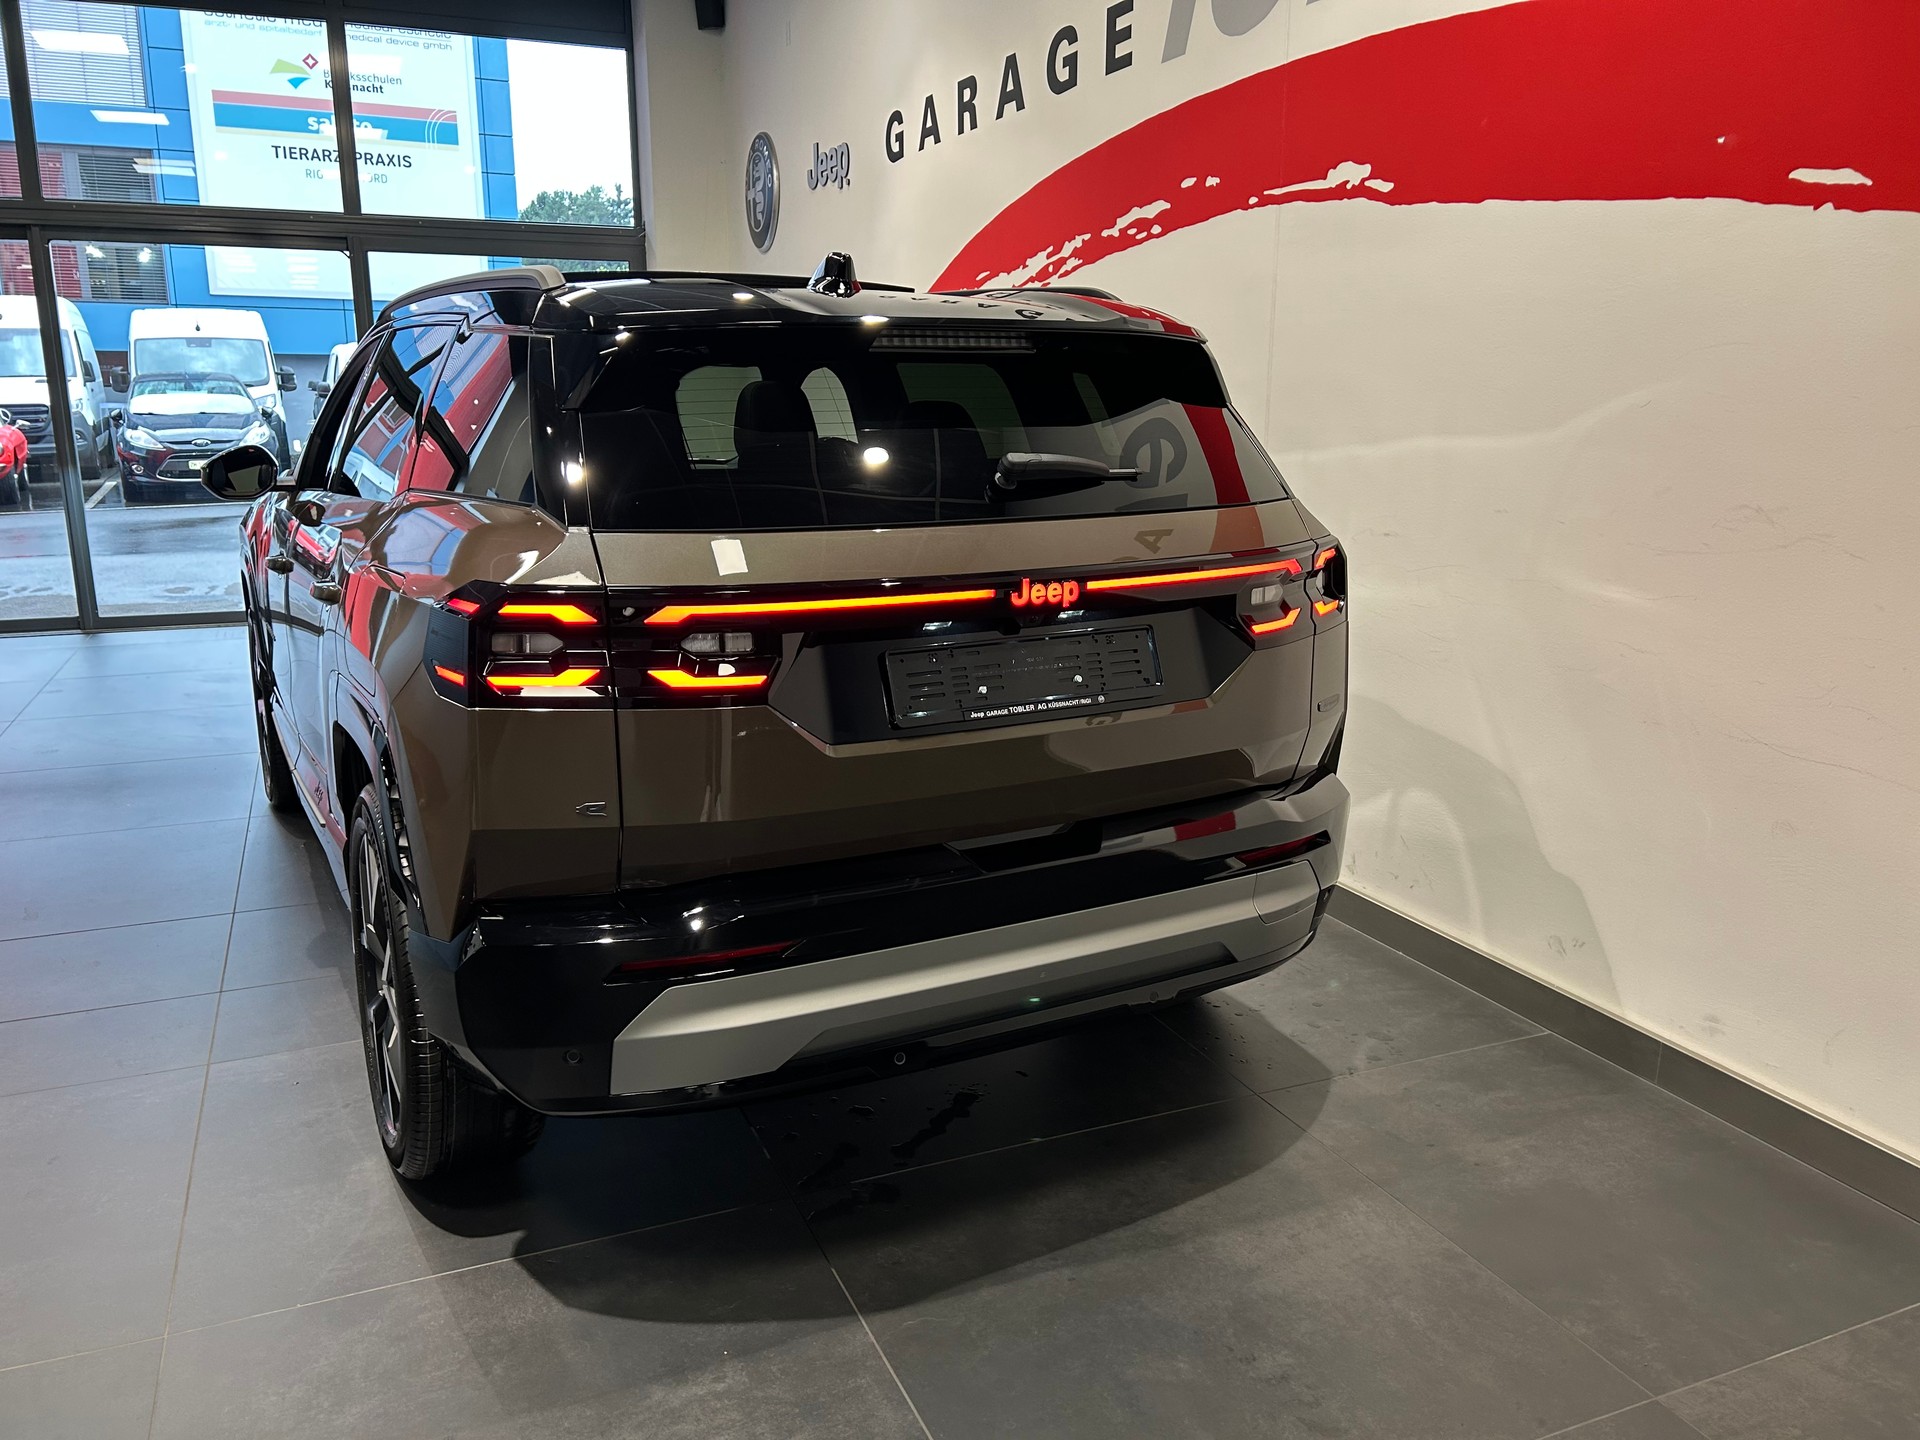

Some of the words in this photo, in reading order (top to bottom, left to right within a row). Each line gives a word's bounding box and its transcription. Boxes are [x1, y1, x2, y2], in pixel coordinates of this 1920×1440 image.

[235, 22, 255, 30] und
[259, 25, 323, 36] spitalbedarf
[386, 37, 419, 47] device
[423, 42, 452, 51] gmbh
[324, 79, 385, 94] Knacht
[886, 0, 1134, 163] GARAGE
[271, 144, 412, 168] TIERARZPRAXIS
[807, 142, 849, 190] Jeep
[1011, 577, 1080, 608] Jeep
[970, 710, 985, 719] Jeep
[986, 708, 1009, 717] GARAGE
[1009, 704, 1035, 714] TOBLER
[1038, 702, 1048, 711] AG
